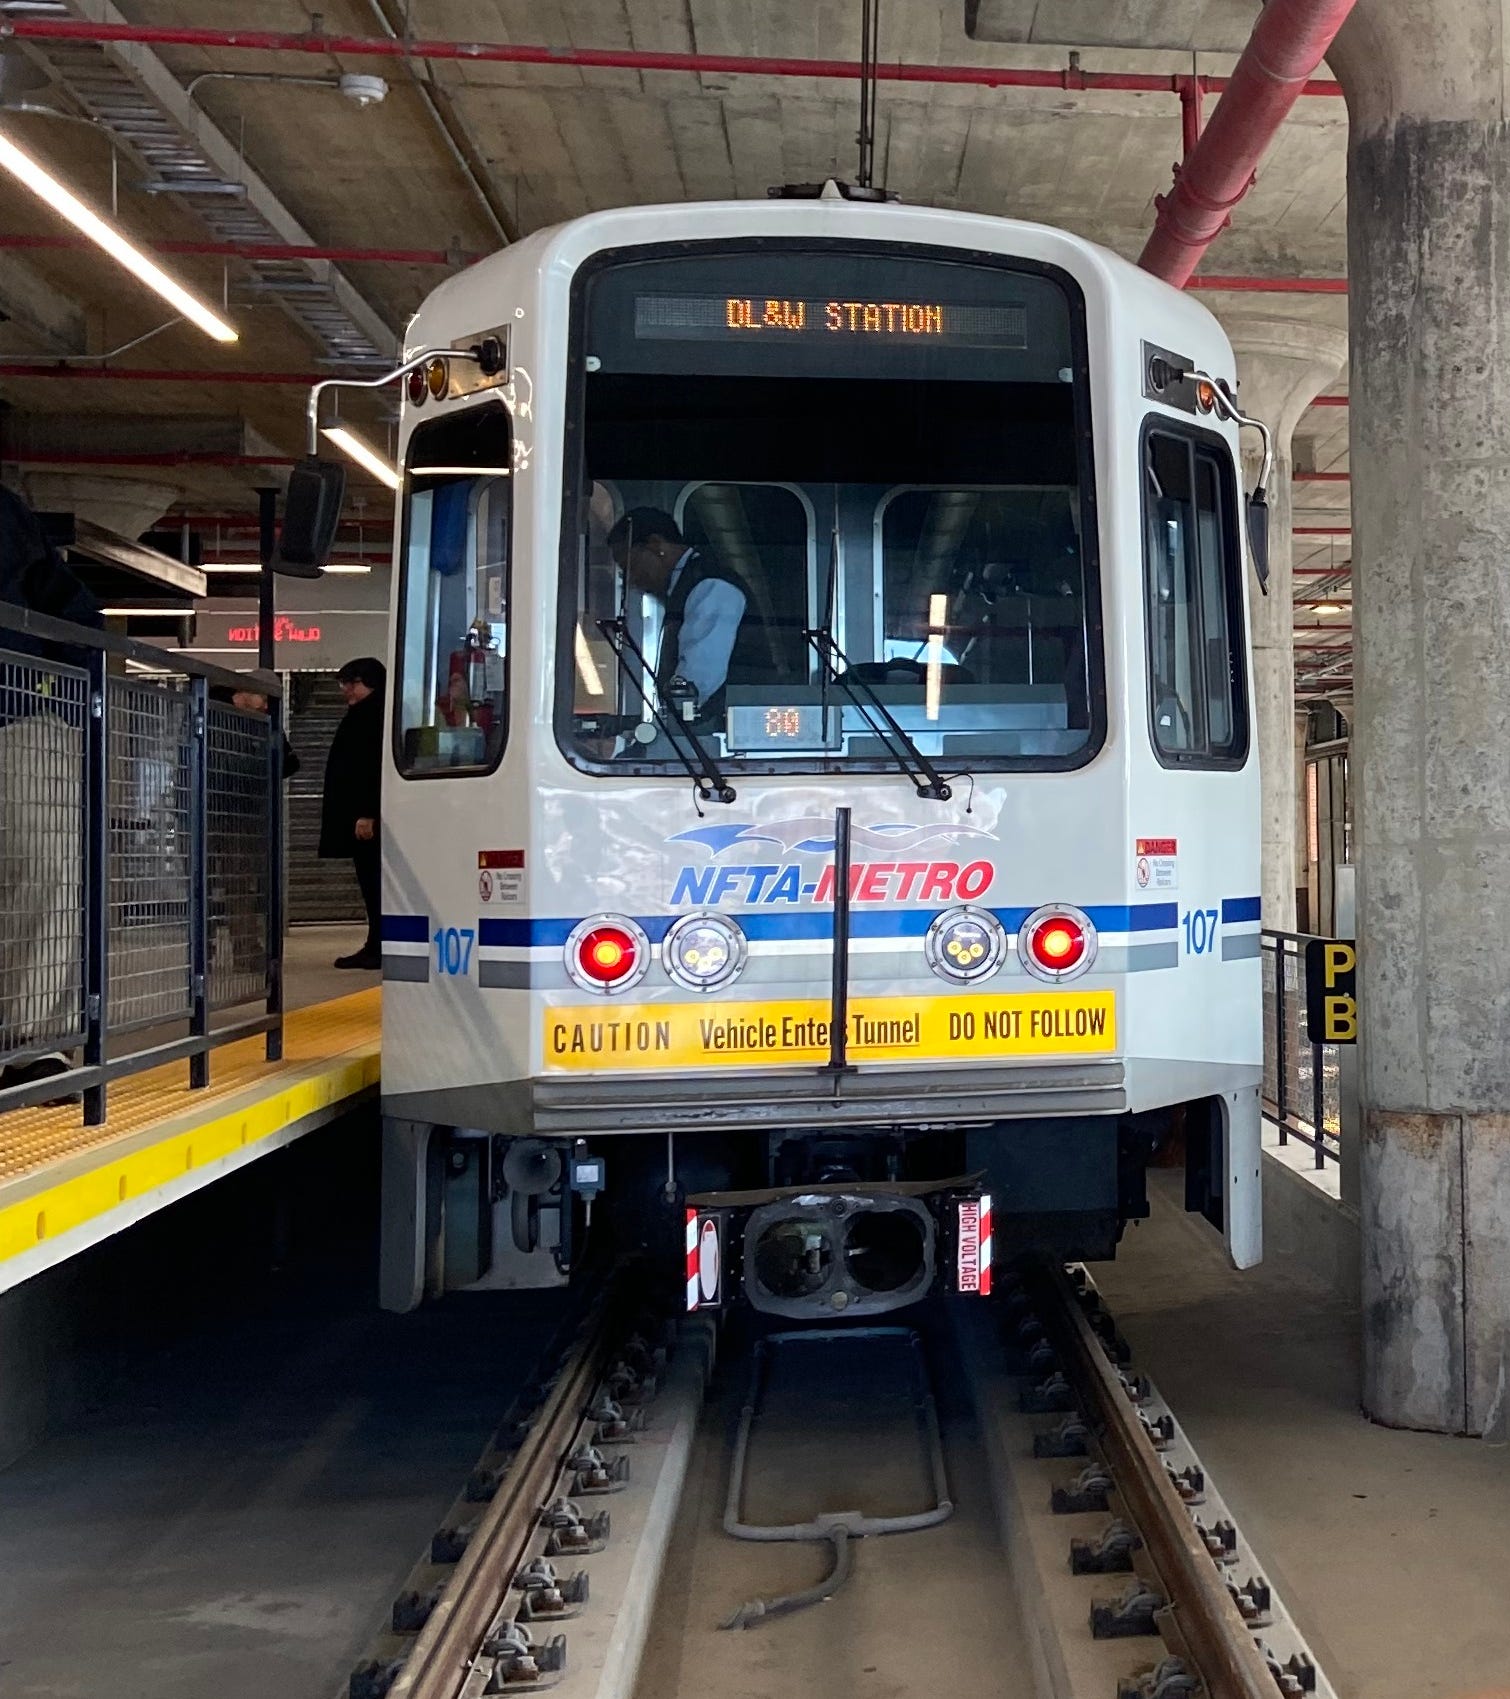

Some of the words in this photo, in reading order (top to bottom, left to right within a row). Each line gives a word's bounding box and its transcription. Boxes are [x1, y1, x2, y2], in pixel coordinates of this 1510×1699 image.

[727, 299, 805, 329] DL&W
[826, 302, 943, 333] STATION
[669, 860, 995, 905] NFTA-METRO
[434, 927, 475, 976] 107
[1182, 909, 1219, 954] 107
[553, 1021, 670, 1053] CAUTION
[700, 1015, 777, 1049] Vehicle
[852, 1013, 920, 1045] Tunnel
[949, 1012, 975, 1041] DO
[984, 1010, 1022, 1039] NOT
[1030, 1007, 1106, 1038] FOLLOW
[961, 1202, 977, 1233] HIGH
[961, 1236, 977, 1290] VOLTAGE
